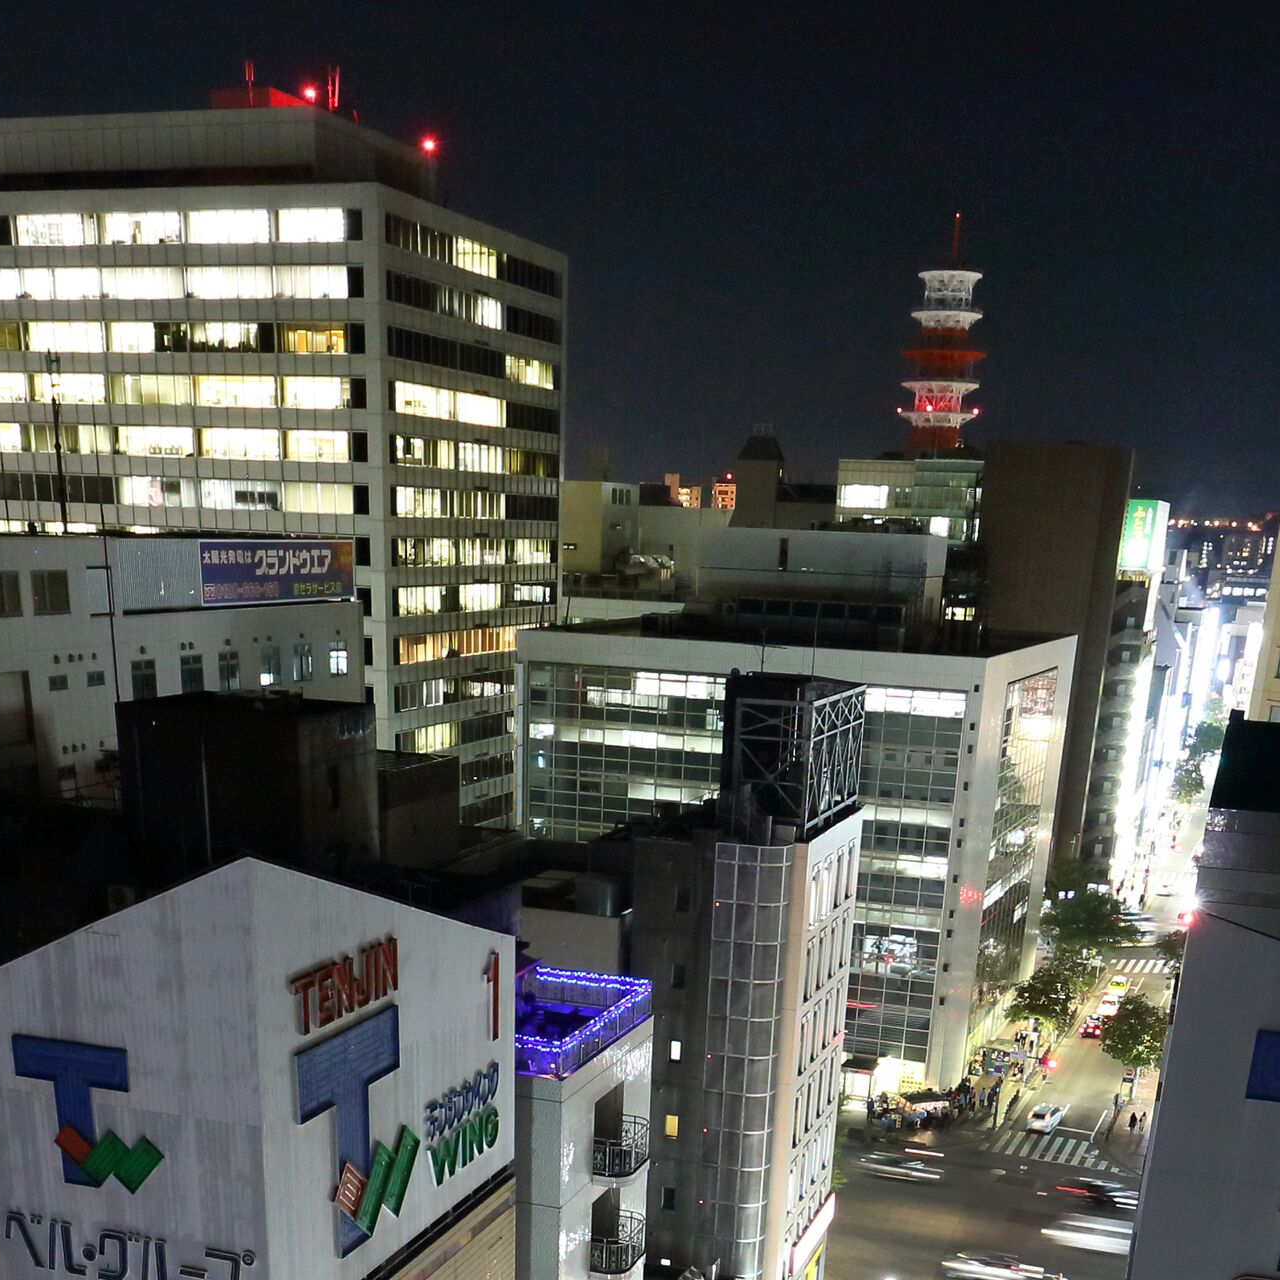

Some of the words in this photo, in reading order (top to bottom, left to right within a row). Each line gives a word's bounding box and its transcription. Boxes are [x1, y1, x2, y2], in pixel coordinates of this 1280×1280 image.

[203, 550, 252, 564] 太陽光発電は
[290, 936, 400, 1036] TENJIN
[482, 949, 501, 1041] 1
[426, 1105, 500, 1187] WING
